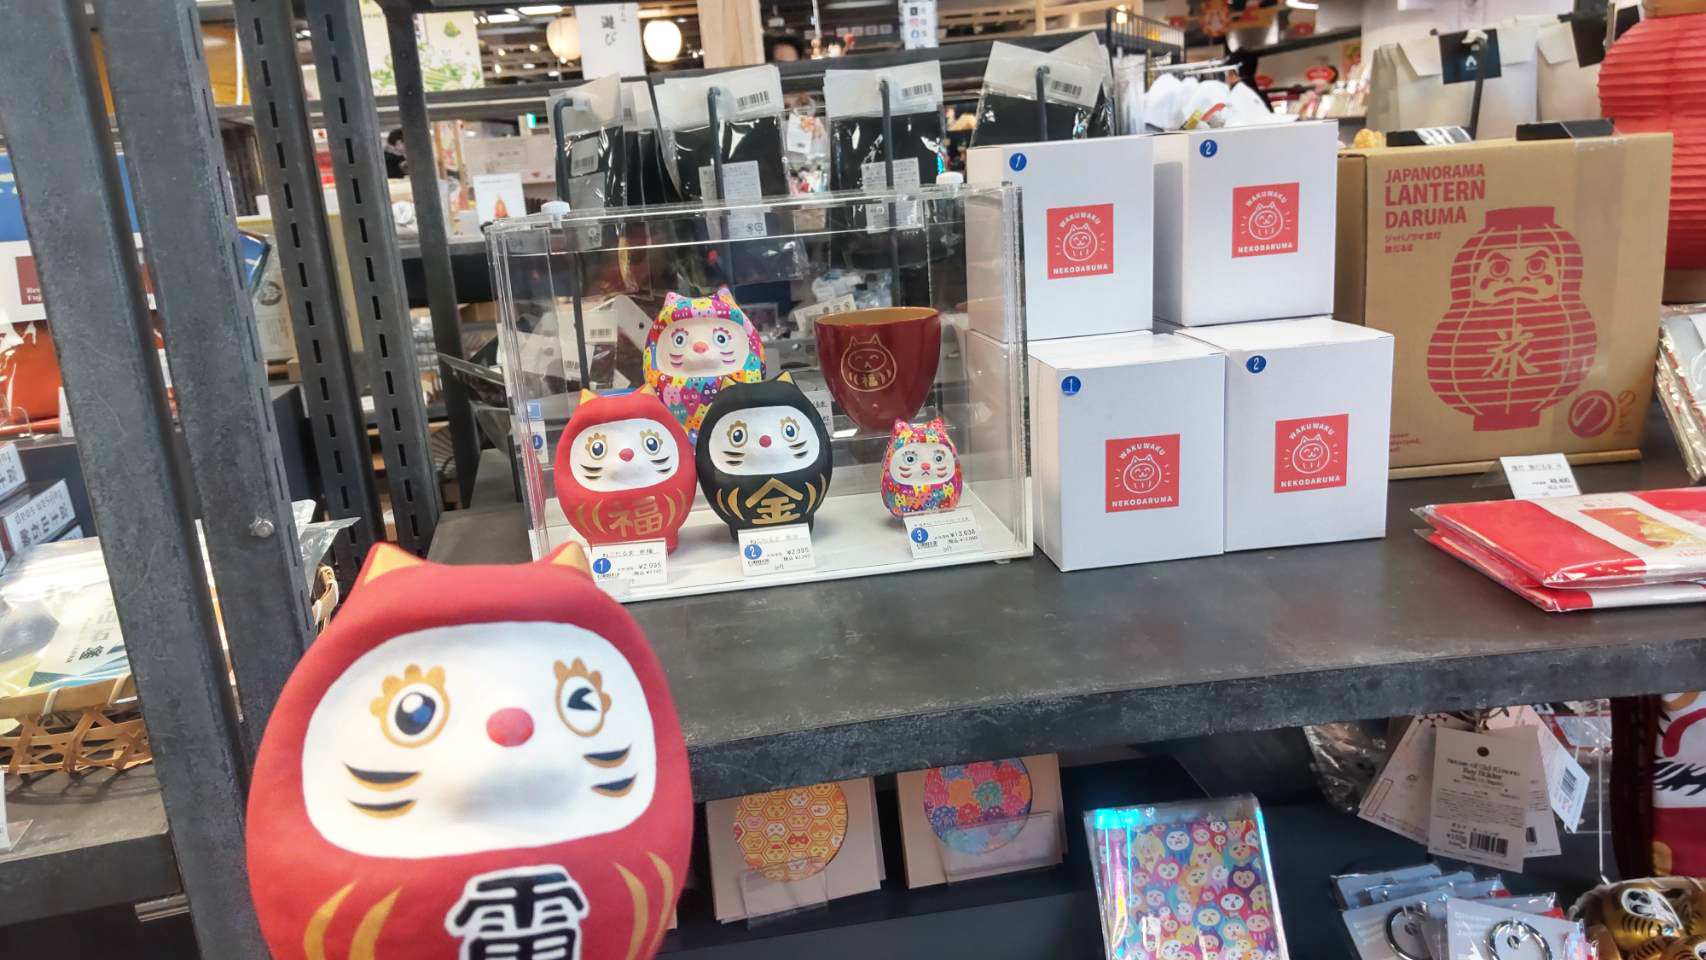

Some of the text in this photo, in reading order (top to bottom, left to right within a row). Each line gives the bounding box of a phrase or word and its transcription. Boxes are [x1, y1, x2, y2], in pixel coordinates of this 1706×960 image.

[1204, 141, 1212, 155] 2
[1384, 163, 1485, 183] JAPANORAMA
[1246, 191, 1288, 206] WAKUWAKU
[1385, 179, 1486, 206] LANTERN
[1059, 212, 1101, 228] WAKUWAKU
[1385, 206, 1467, 229] DARUMA
[1238, 242, 1293, 253] NEKODARUMA
[1053, 263, 1108, 274] NEKODARUMA
[1481, 322, 1542, 382] 旅
[1253, 357, 1260, 371] 2
[1289, 423, 1335, 440] WAKUWAKU
[1120, 443, 1166, 460] WAKUWAKU
[1280, 475, 1341, 487] NEKODARUMA
[745, 477, 803, 525] 金
[1112, 496, 1173, 507] NEKODARUMA
[608, 495, 663, 537] 福
